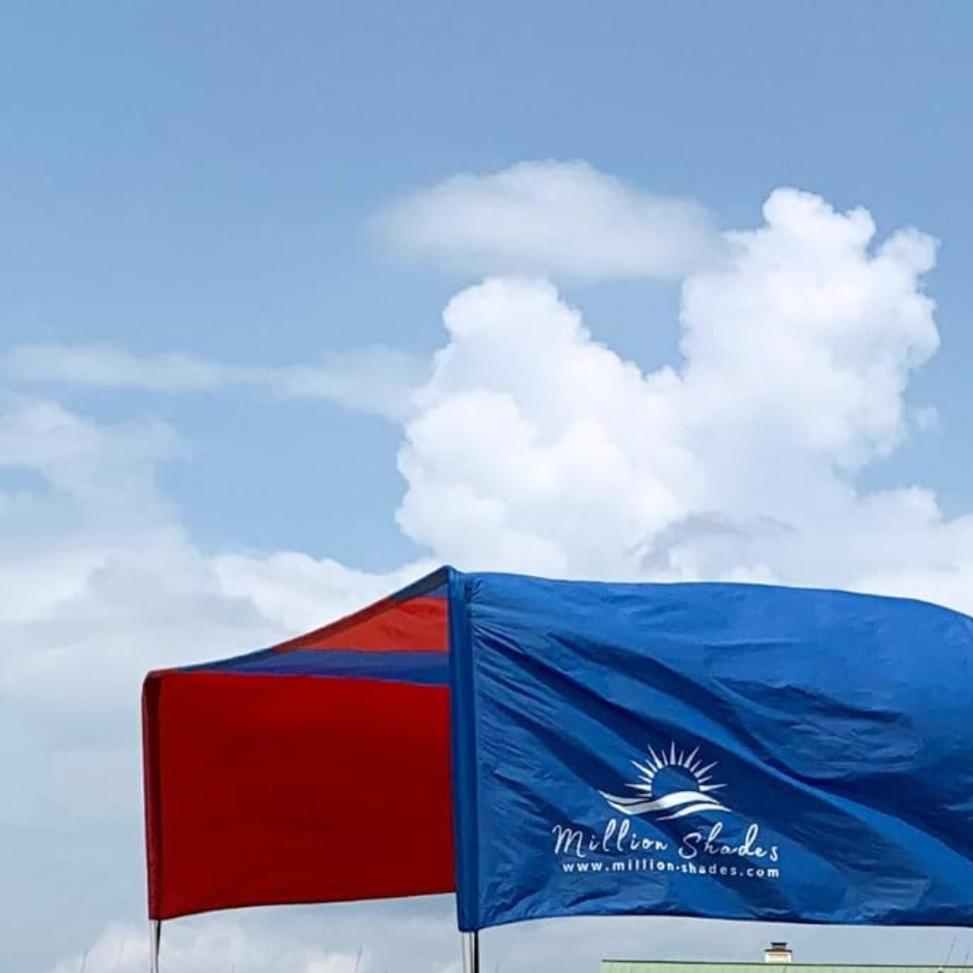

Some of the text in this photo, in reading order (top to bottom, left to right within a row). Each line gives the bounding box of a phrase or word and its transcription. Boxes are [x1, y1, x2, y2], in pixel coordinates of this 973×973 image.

[552, 819, 779, 861] Million Shades
[562, 860, 779, 878] www.million-shades.com
